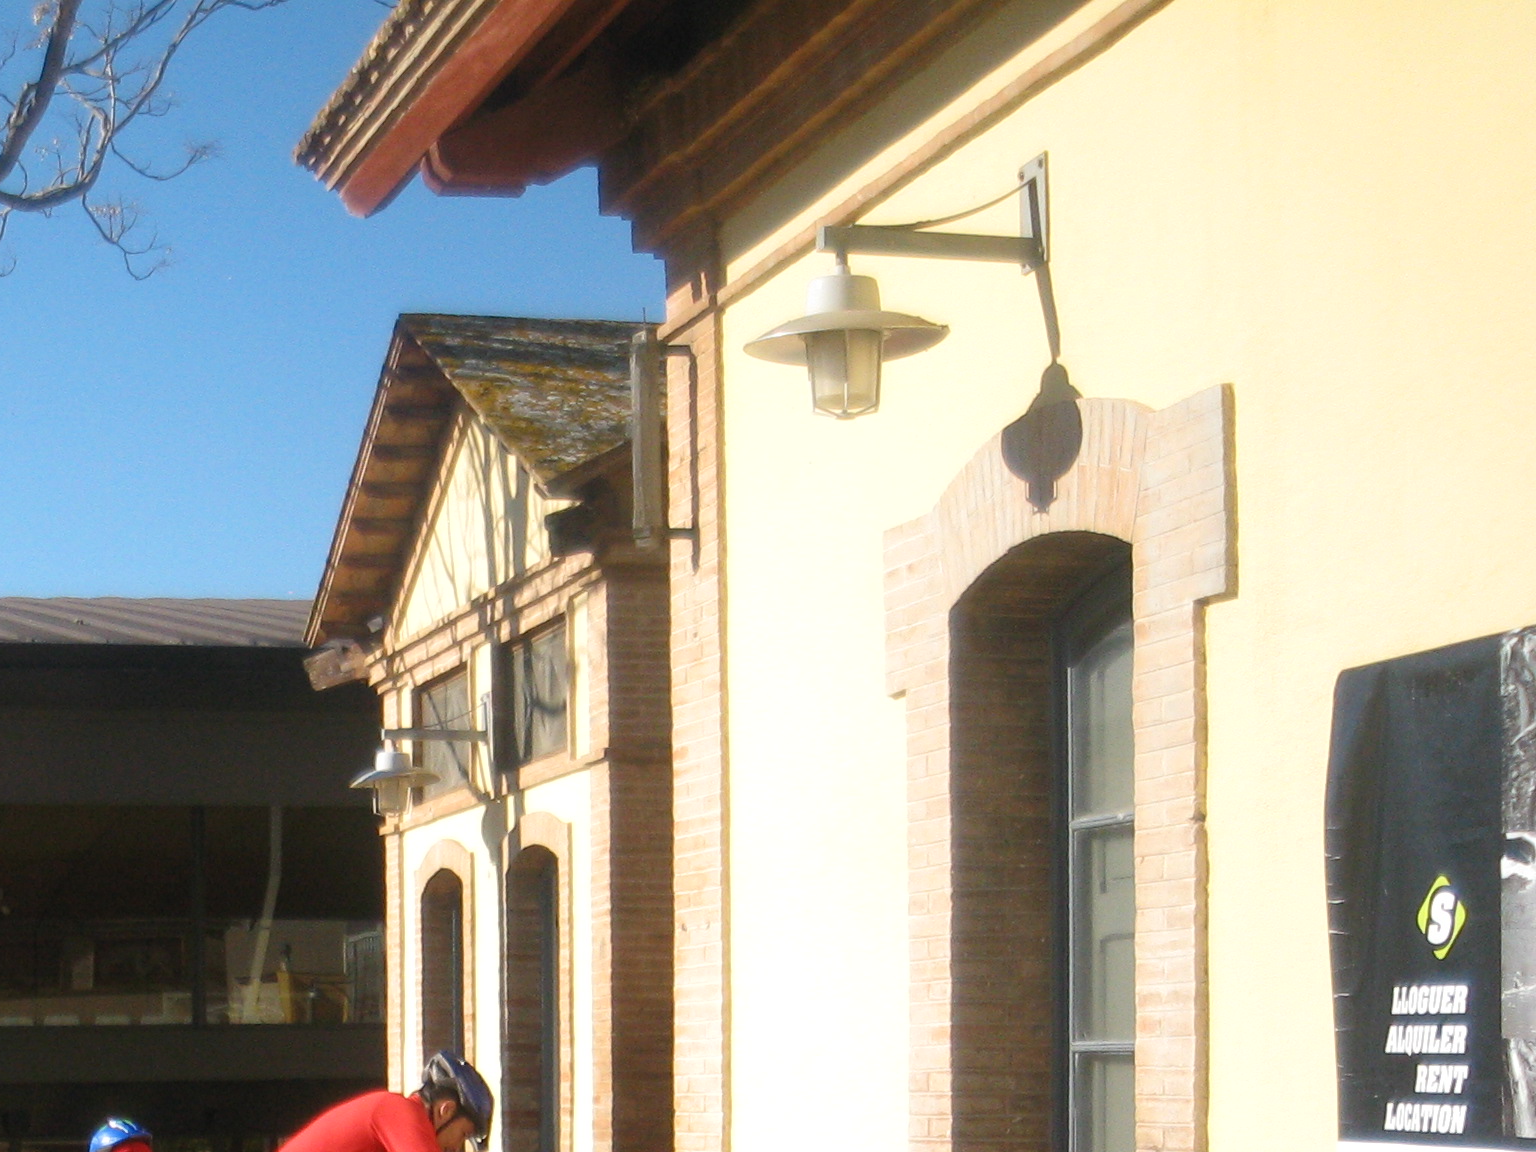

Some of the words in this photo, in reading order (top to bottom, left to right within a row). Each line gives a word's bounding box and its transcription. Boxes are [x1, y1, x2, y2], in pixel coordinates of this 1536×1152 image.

[1427, 891, 1455, 945] S
[1391, 985, 1469, 1015] LLOGUER
[1385, 1024, 1468, 1057] ALQUILER
[1414, 1064, 1469, 1094] RENT
[1384, 1102, 1467, 1135] LOCATION
